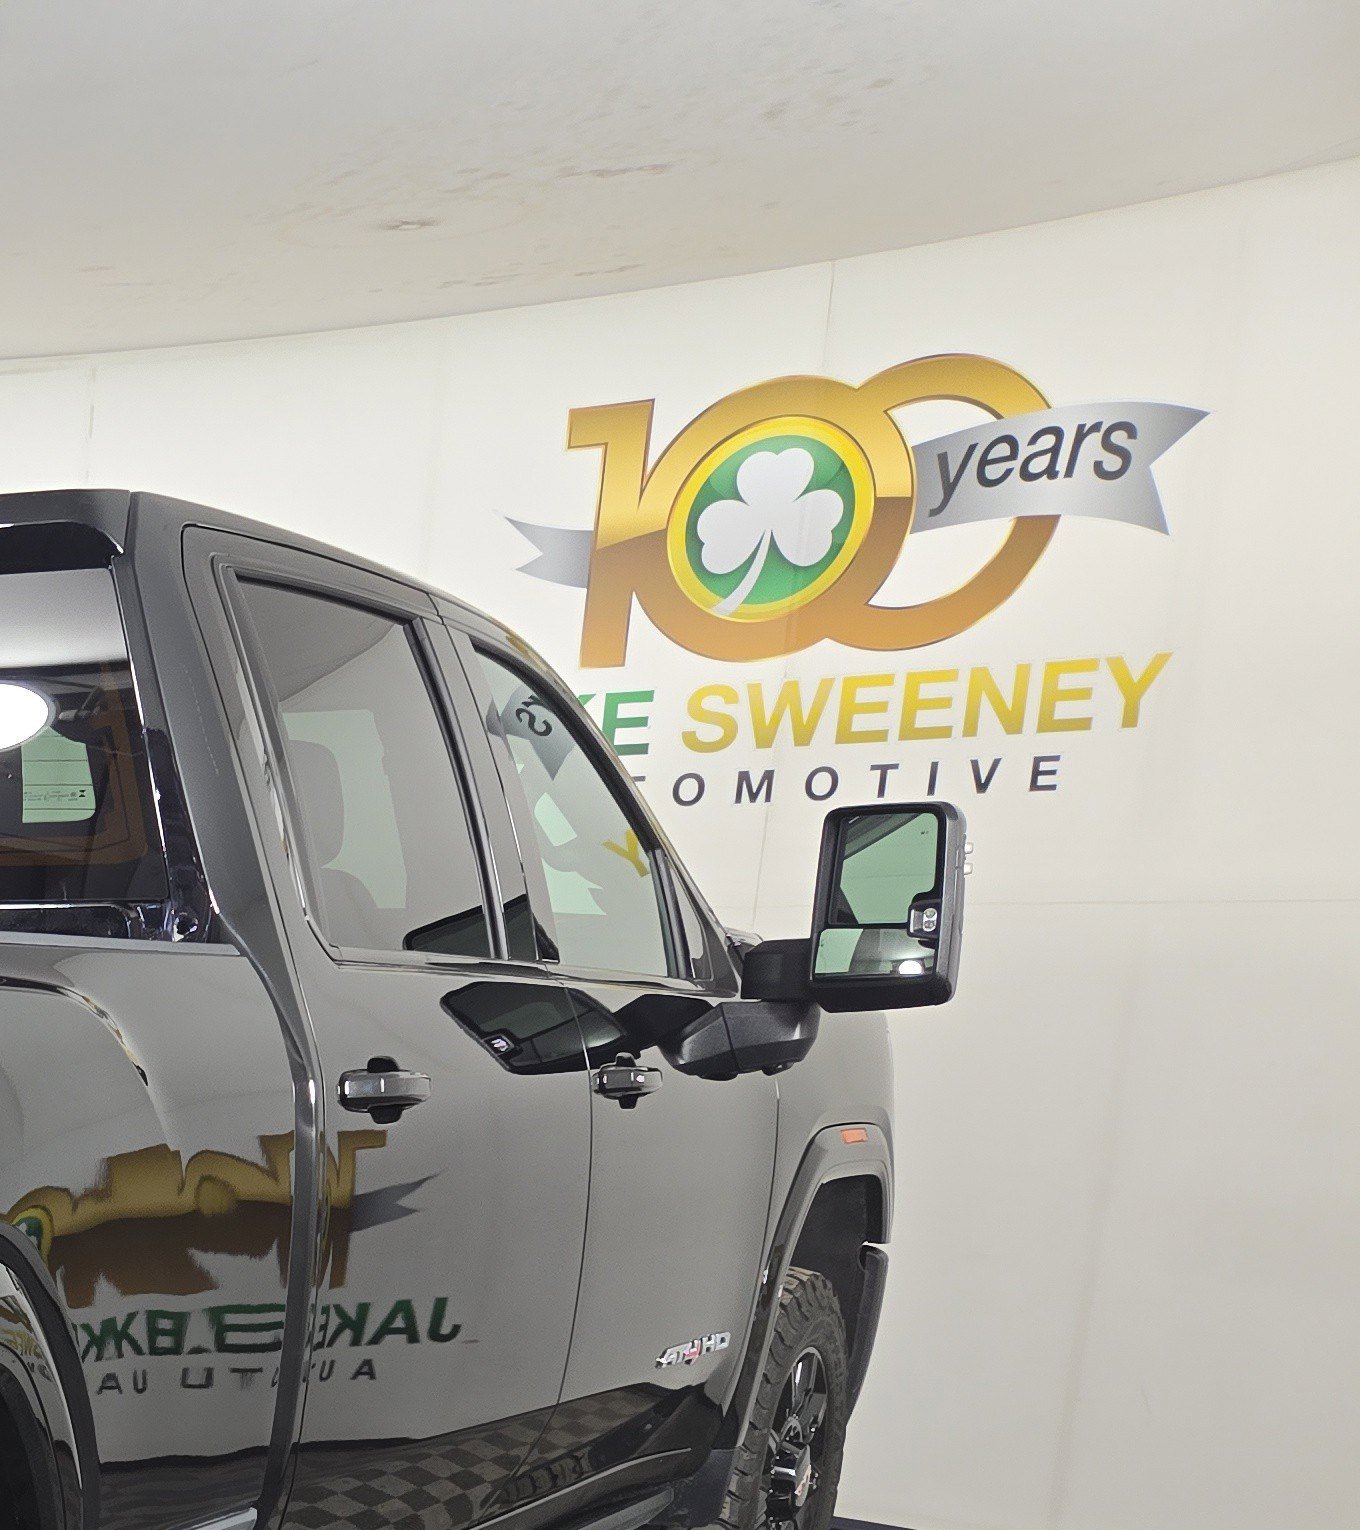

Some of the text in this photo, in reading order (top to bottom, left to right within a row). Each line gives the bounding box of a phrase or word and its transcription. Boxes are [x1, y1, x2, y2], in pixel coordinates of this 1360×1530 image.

[566, 353, 1062, 670] 100
[927, 416, 1139, 518] years
[681, 652, 1173, 755] SWEENEY
